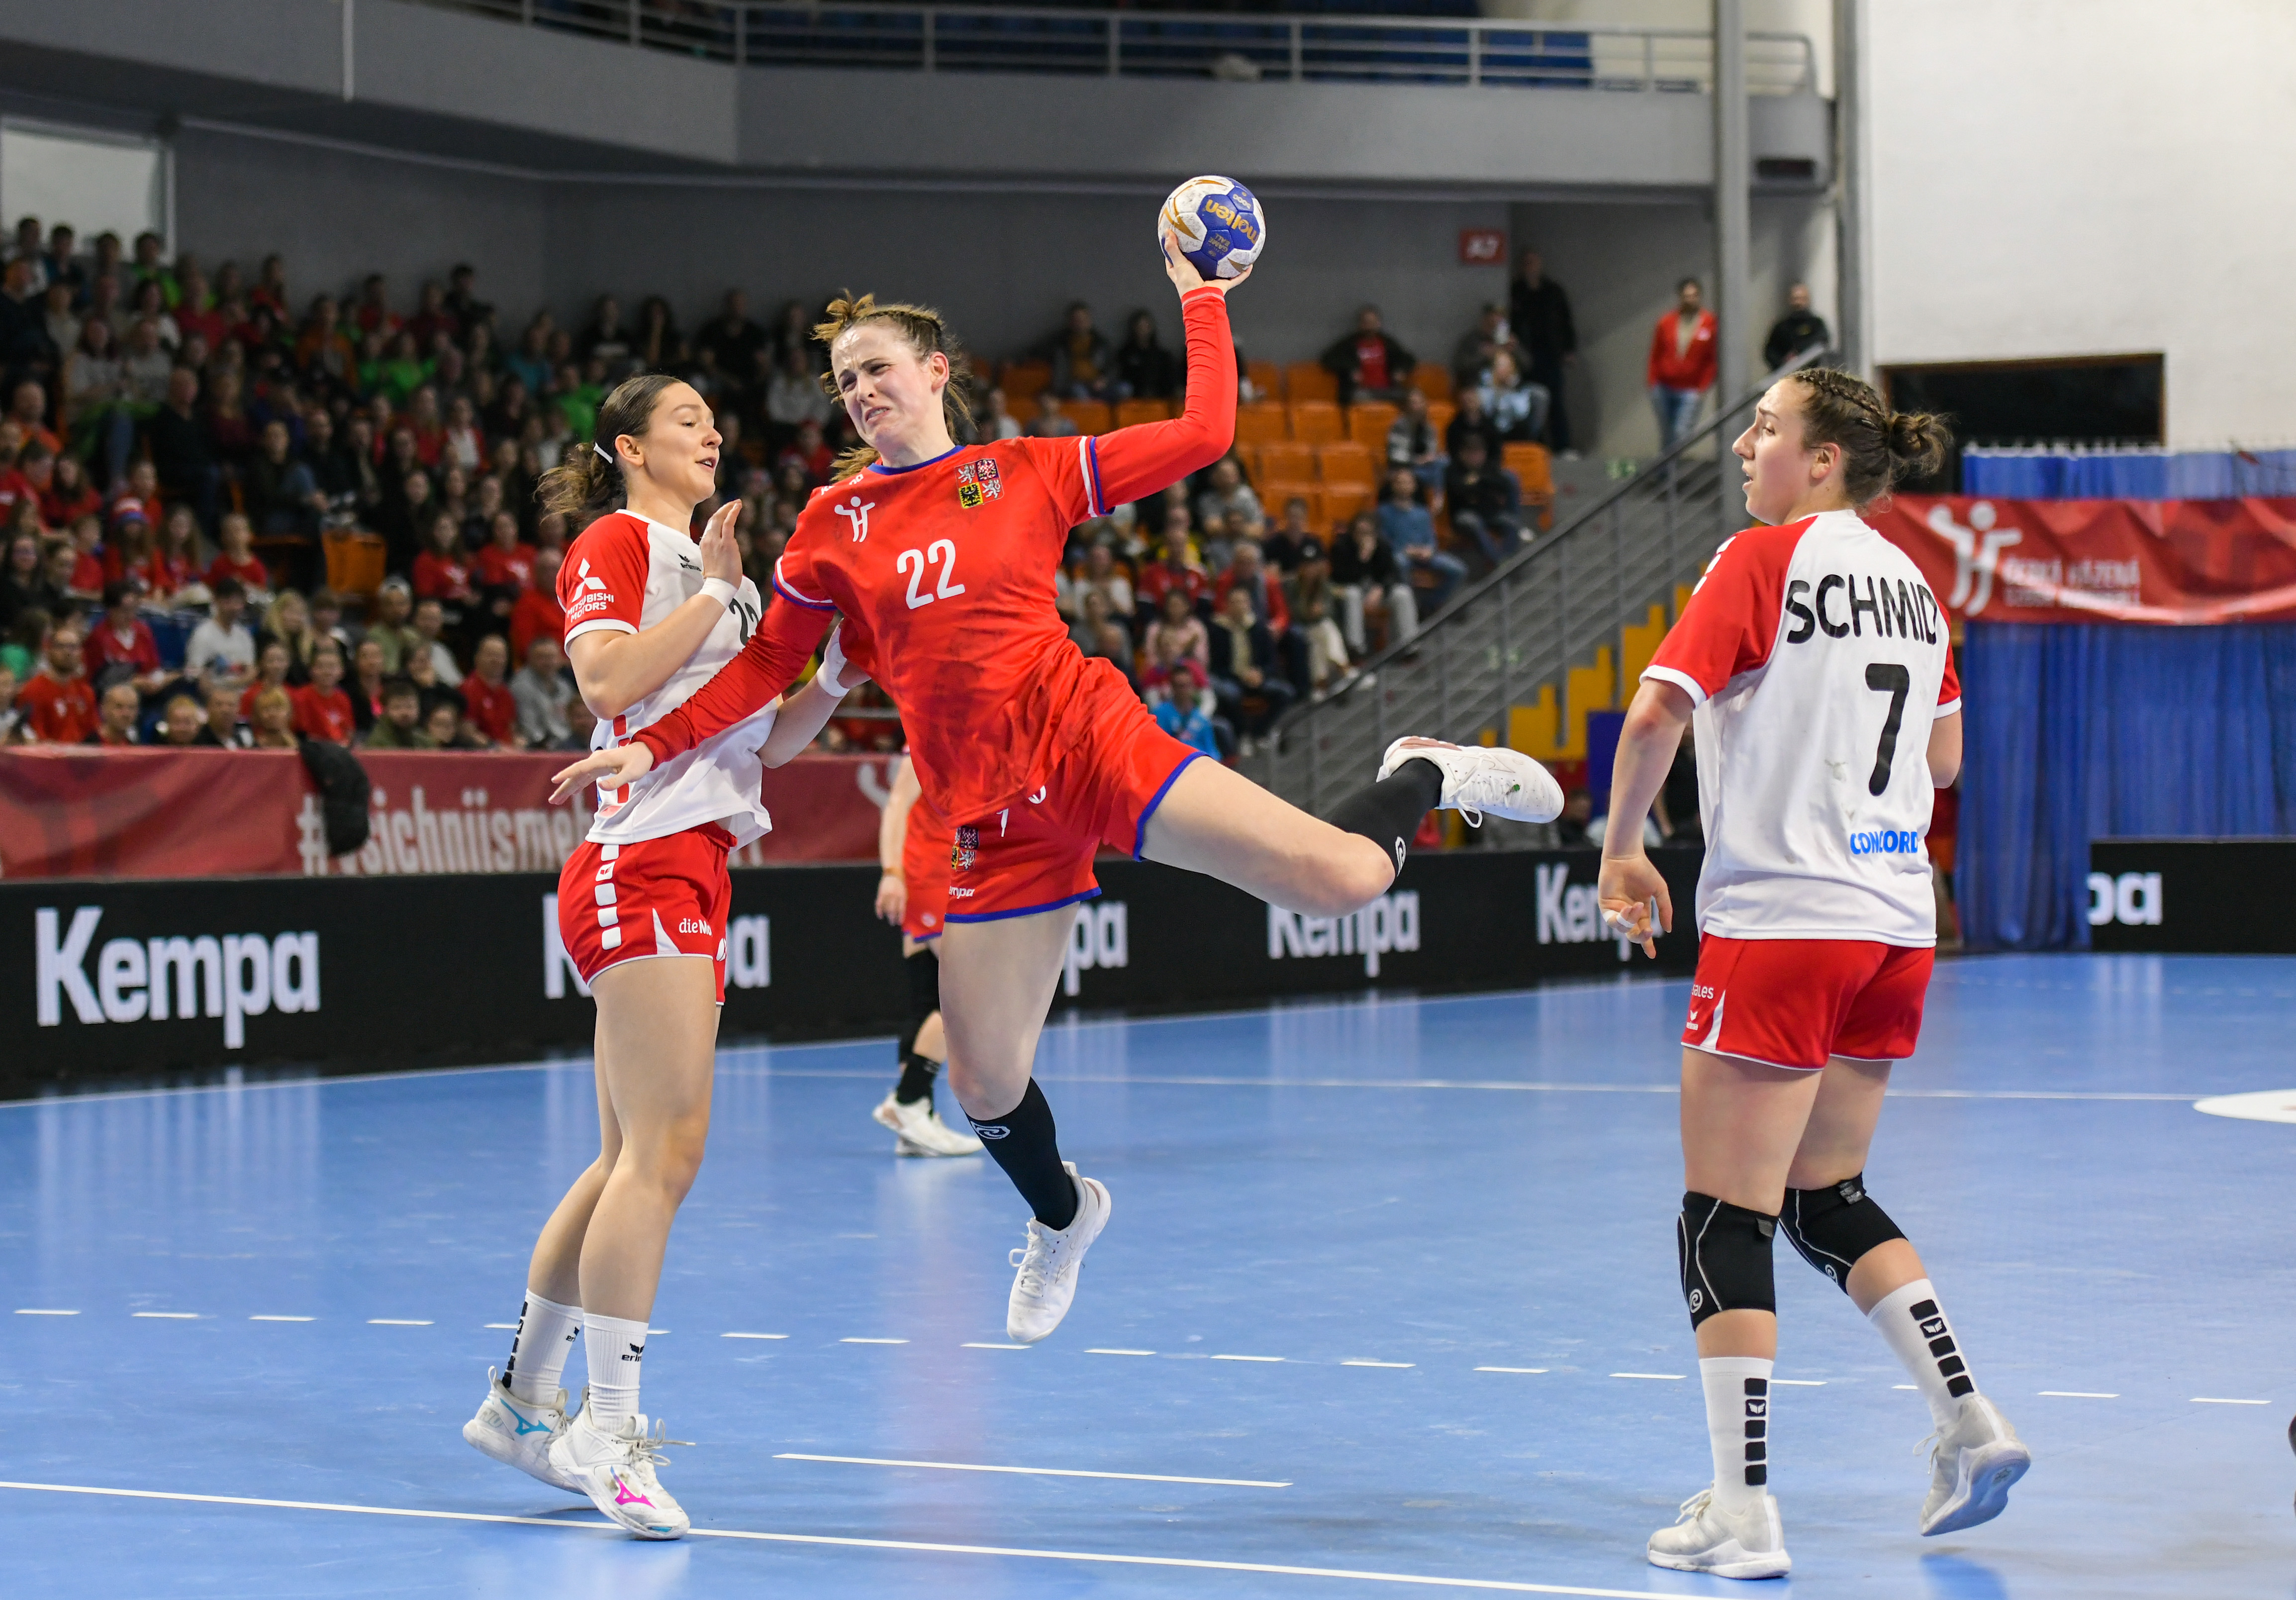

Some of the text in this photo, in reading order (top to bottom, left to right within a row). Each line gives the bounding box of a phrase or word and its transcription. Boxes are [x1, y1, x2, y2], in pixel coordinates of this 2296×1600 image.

[1205, 199, 1259, 244] molten
[1208, 237, 1228, 252] GAME
[896, 539, 965, 609] 22
[567, 593, 614, 618] MITSUBISHI
[571, 601, 607, 623] MOTORS
[1785, 574, 1937, 645] SCHMID
[1865, 663, 1910, 796] 7
[36, 905, 321, 1049] Kempa
